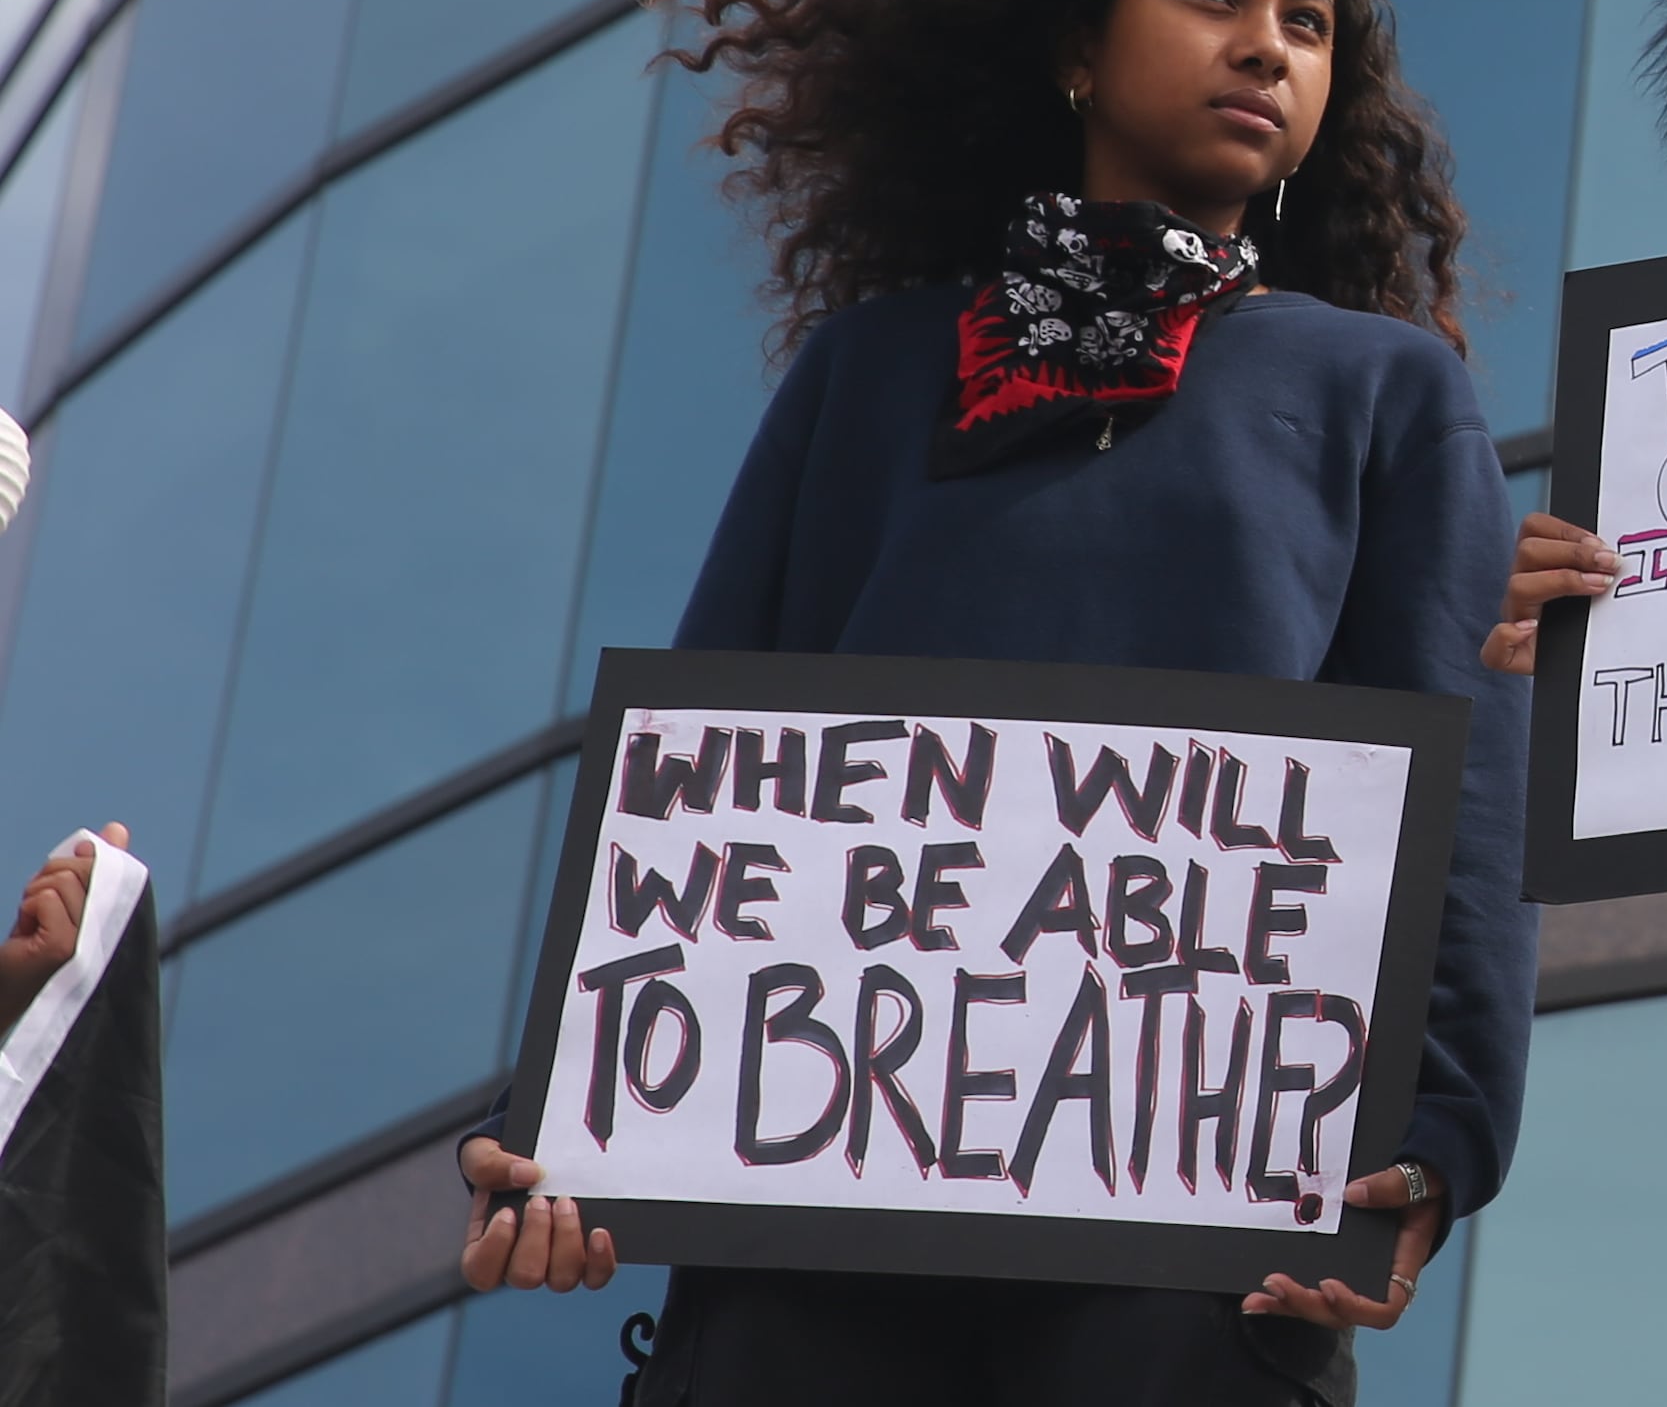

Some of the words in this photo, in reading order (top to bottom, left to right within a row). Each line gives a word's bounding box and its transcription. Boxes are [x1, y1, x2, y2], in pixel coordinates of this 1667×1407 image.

[620, 720, 997, 830] WHEN
[1044, 730, 1342, 863] WILL
[609, 841, 791, 943] WE
[841, 841, 986, 951] BE
[1001, 842, 1327, 985] ABLE
[579, 943, 703, 1152] TO
[734, 960, 1368, 1227] BREATHE?
